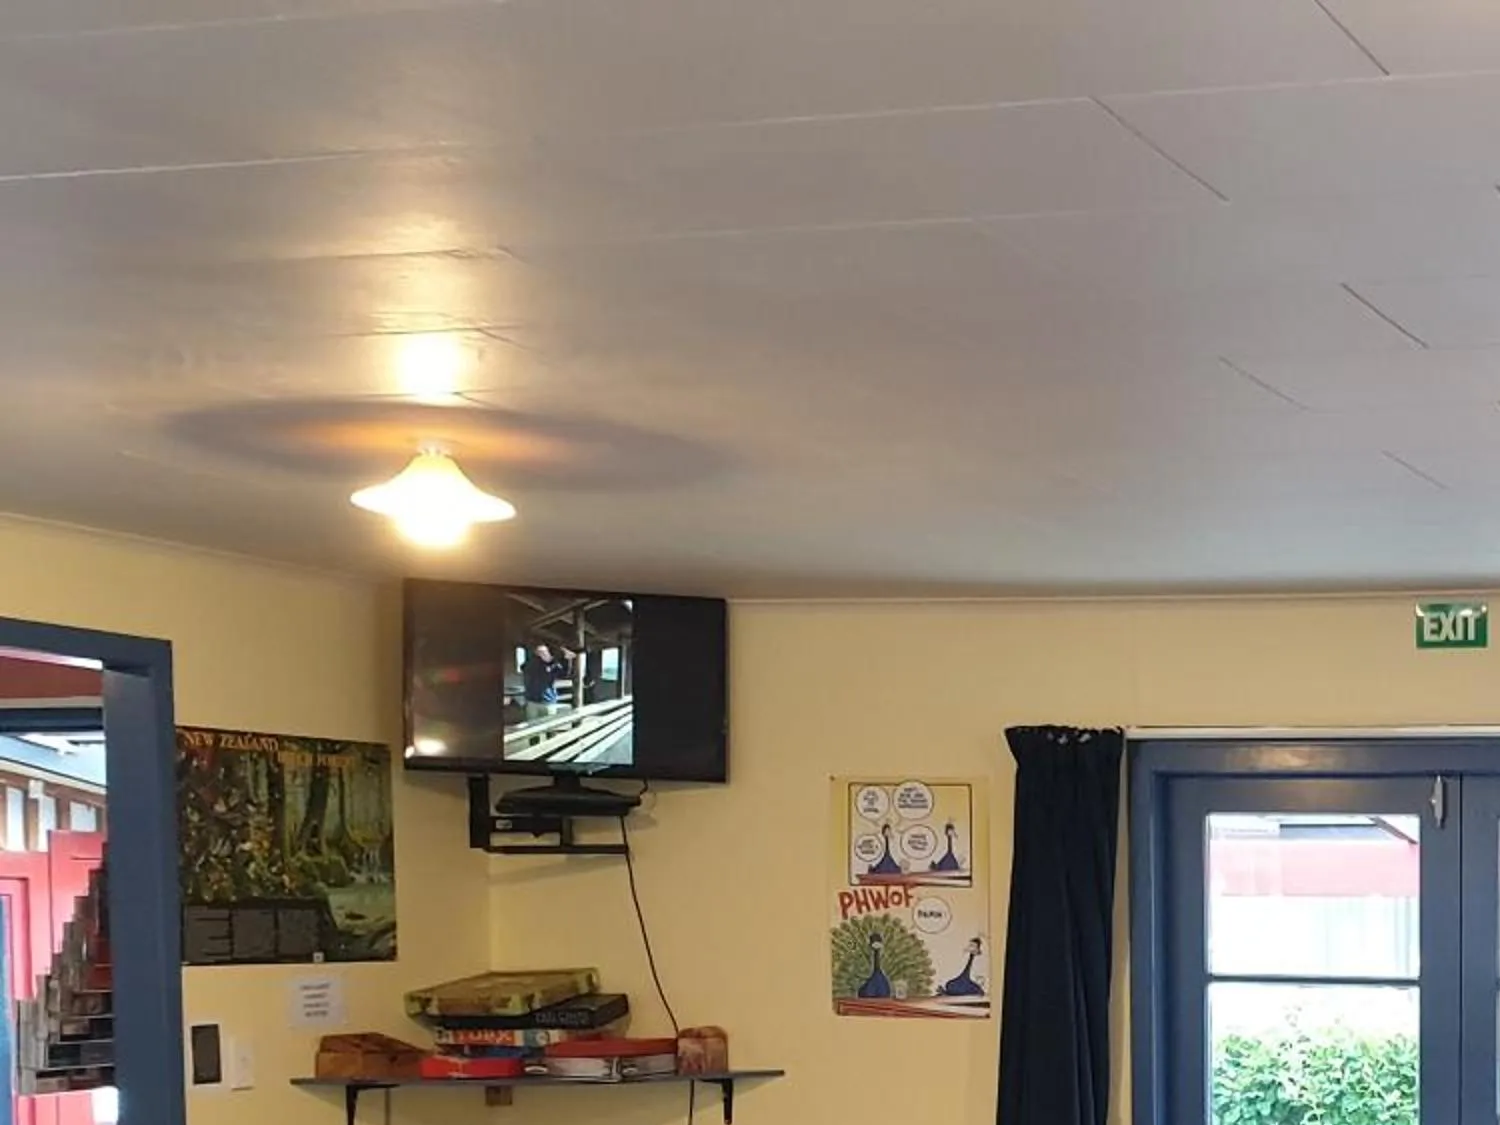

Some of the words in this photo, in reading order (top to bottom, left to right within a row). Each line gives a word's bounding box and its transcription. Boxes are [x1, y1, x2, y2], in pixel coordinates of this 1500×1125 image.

[1423, 611, 1480, 641] EXIT
[184, 732, 215, 747] NEW
[219, 733, 279, 752] ZEALAND
[838, 886, 914, 919] PHWOF
